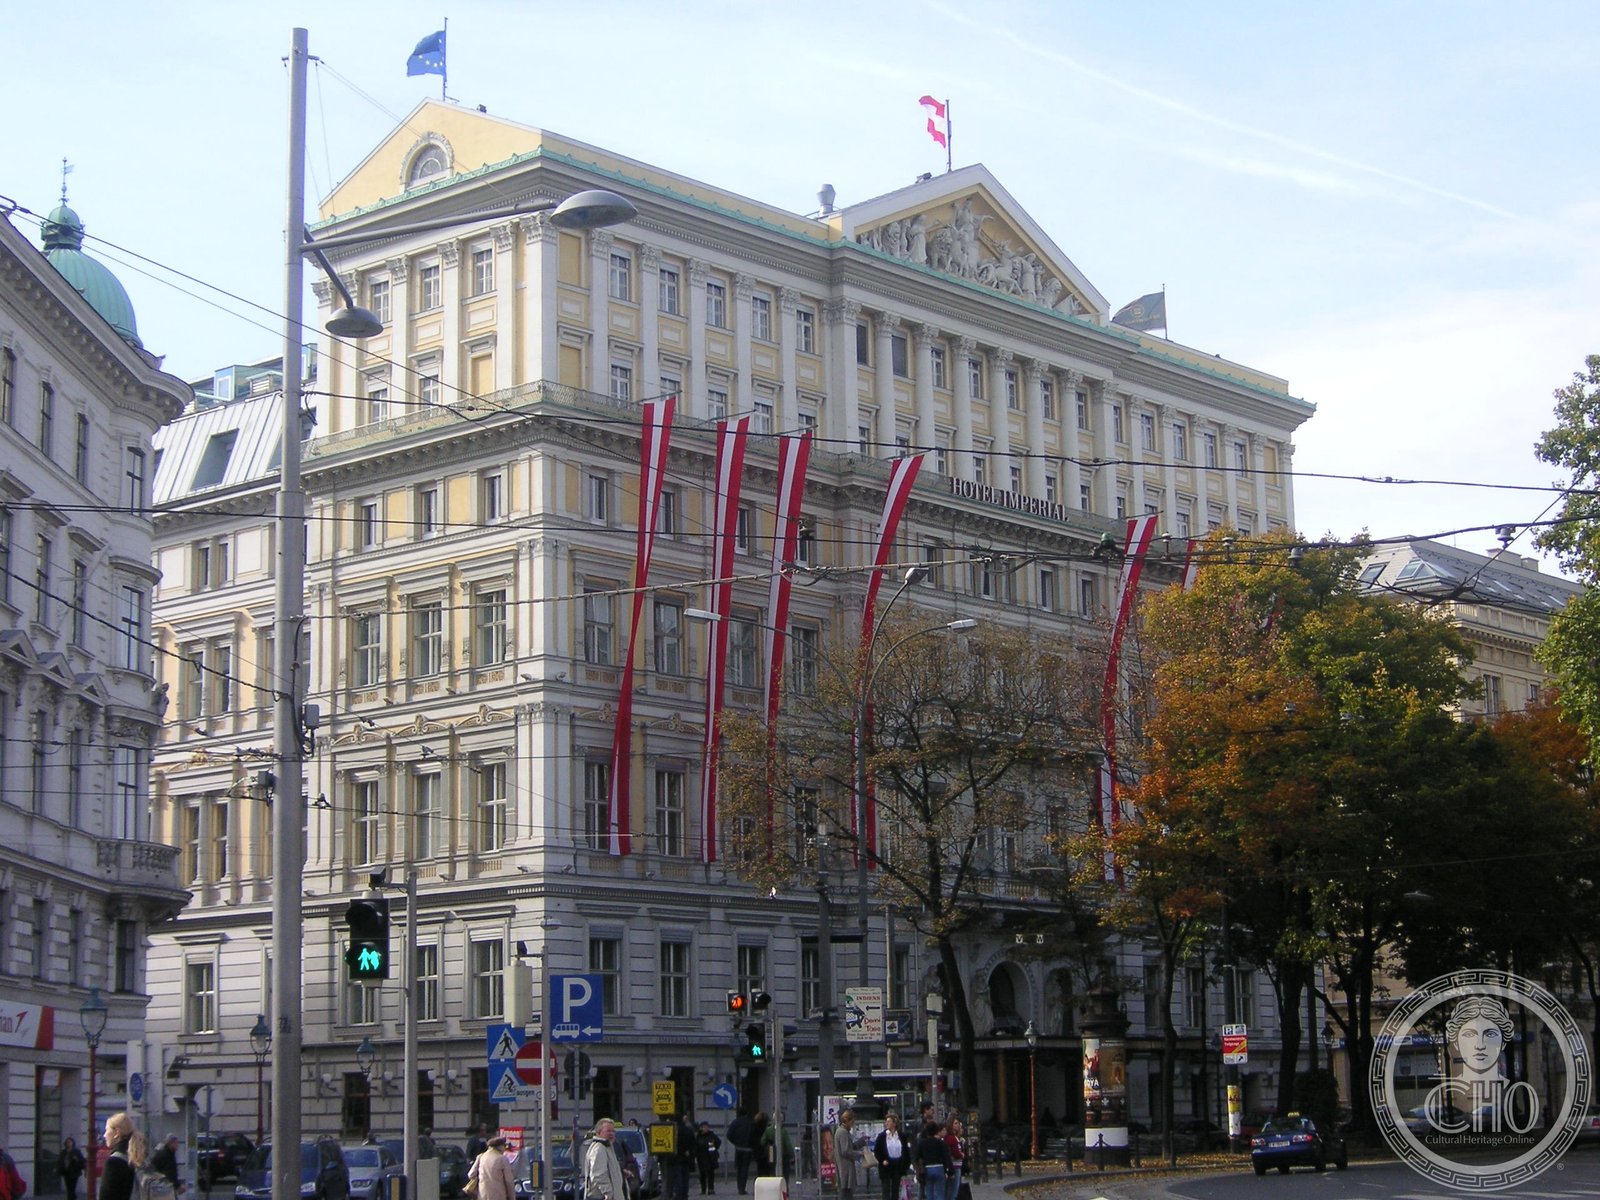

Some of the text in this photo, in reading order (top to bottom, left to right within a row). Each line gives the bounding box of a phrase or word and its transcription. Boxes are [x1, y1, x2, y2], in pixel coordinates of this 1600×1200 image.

[951, 476, 1069, 522] HOTEL IMPERIAL
[563, 977, 592, 1022] P
